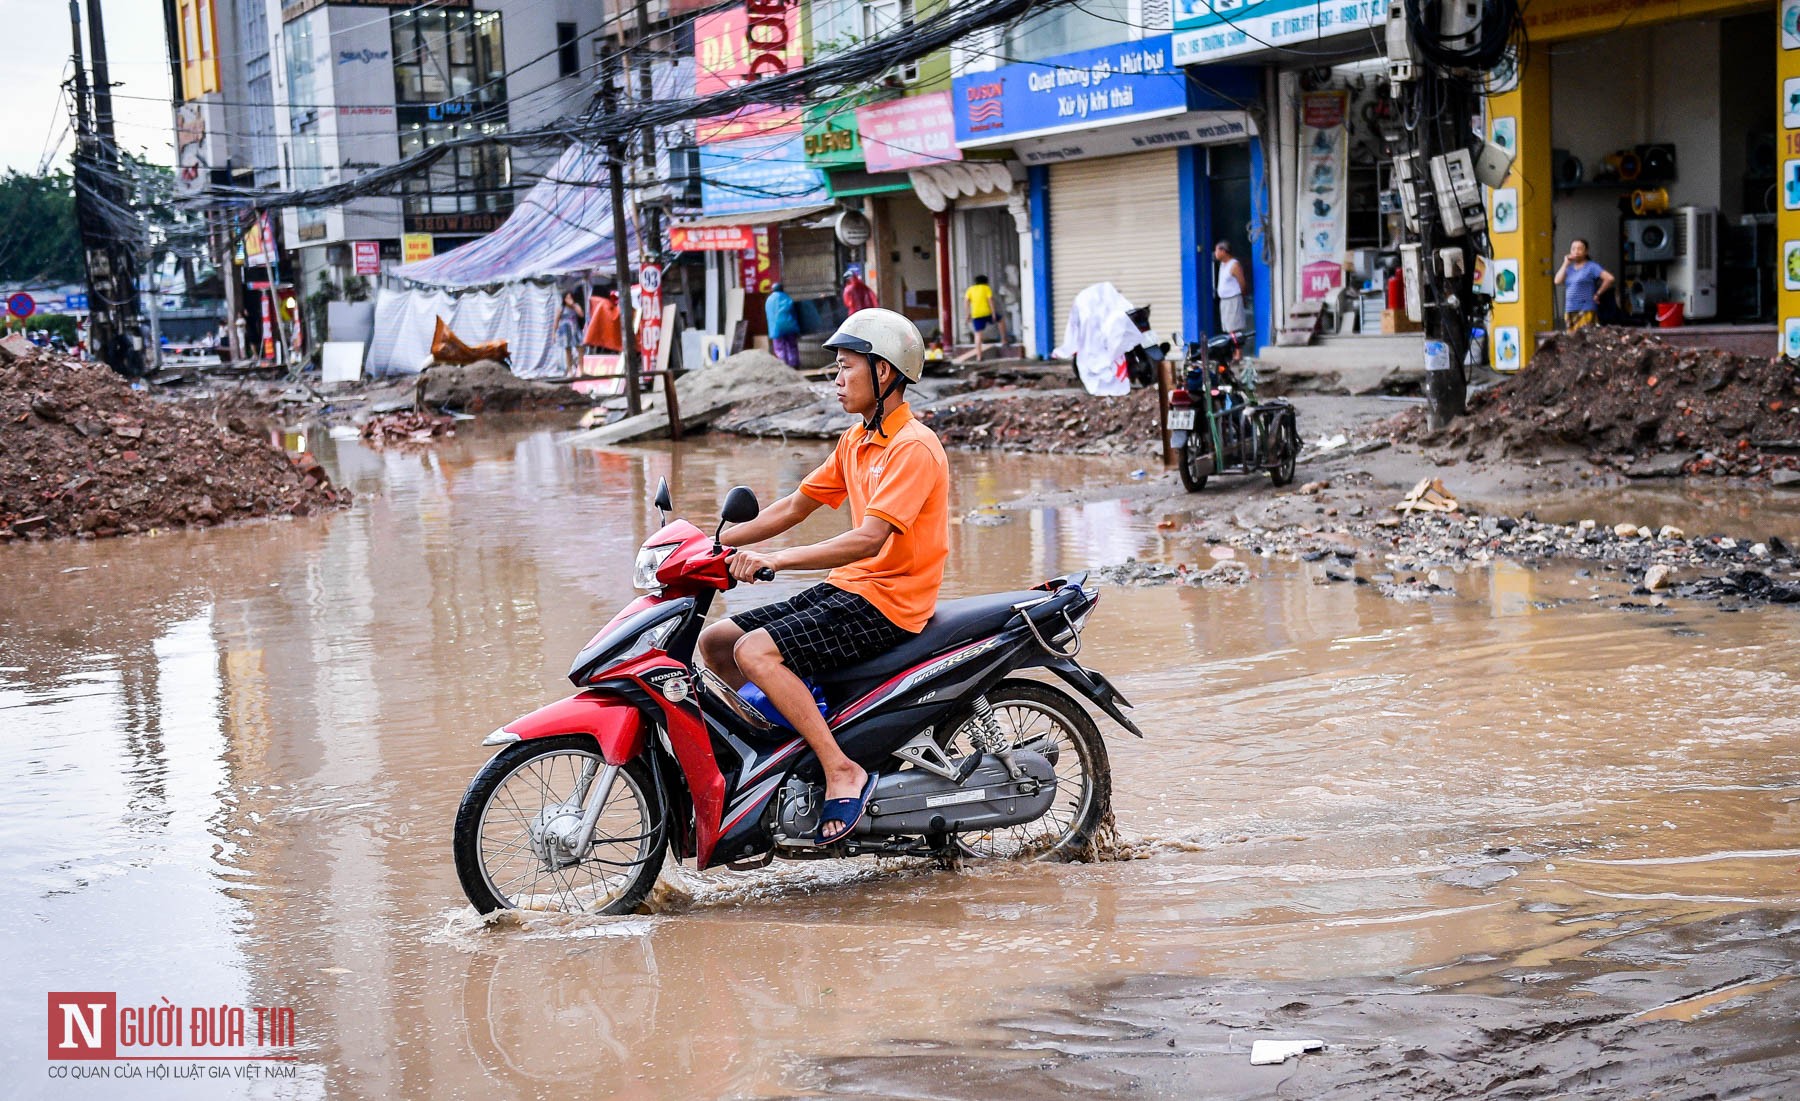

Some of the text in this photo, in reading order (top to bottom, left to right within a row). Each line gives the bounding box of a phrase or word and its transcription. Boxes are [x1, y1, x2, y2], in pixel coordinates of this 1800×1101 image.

[1028, 69, 1056, 93] Quạt
[1057, 65, 1089, 88] thông
[1091, 57, 1112, 85] gió
[1120, 52, 1143, 74] Hút
[1143, 49, 1164, 74] bụi
[967, 82, 1003, 102] DUSON
[1077, 93, 1088, 118] lý
[1090, 90, 1108, 112] khí
[1110, 85, 1133, 108] thải
[644, 271, 658, 287] 93
[651, 670, 684, 682] HONDA
[917, 690, 936, 704] 110
